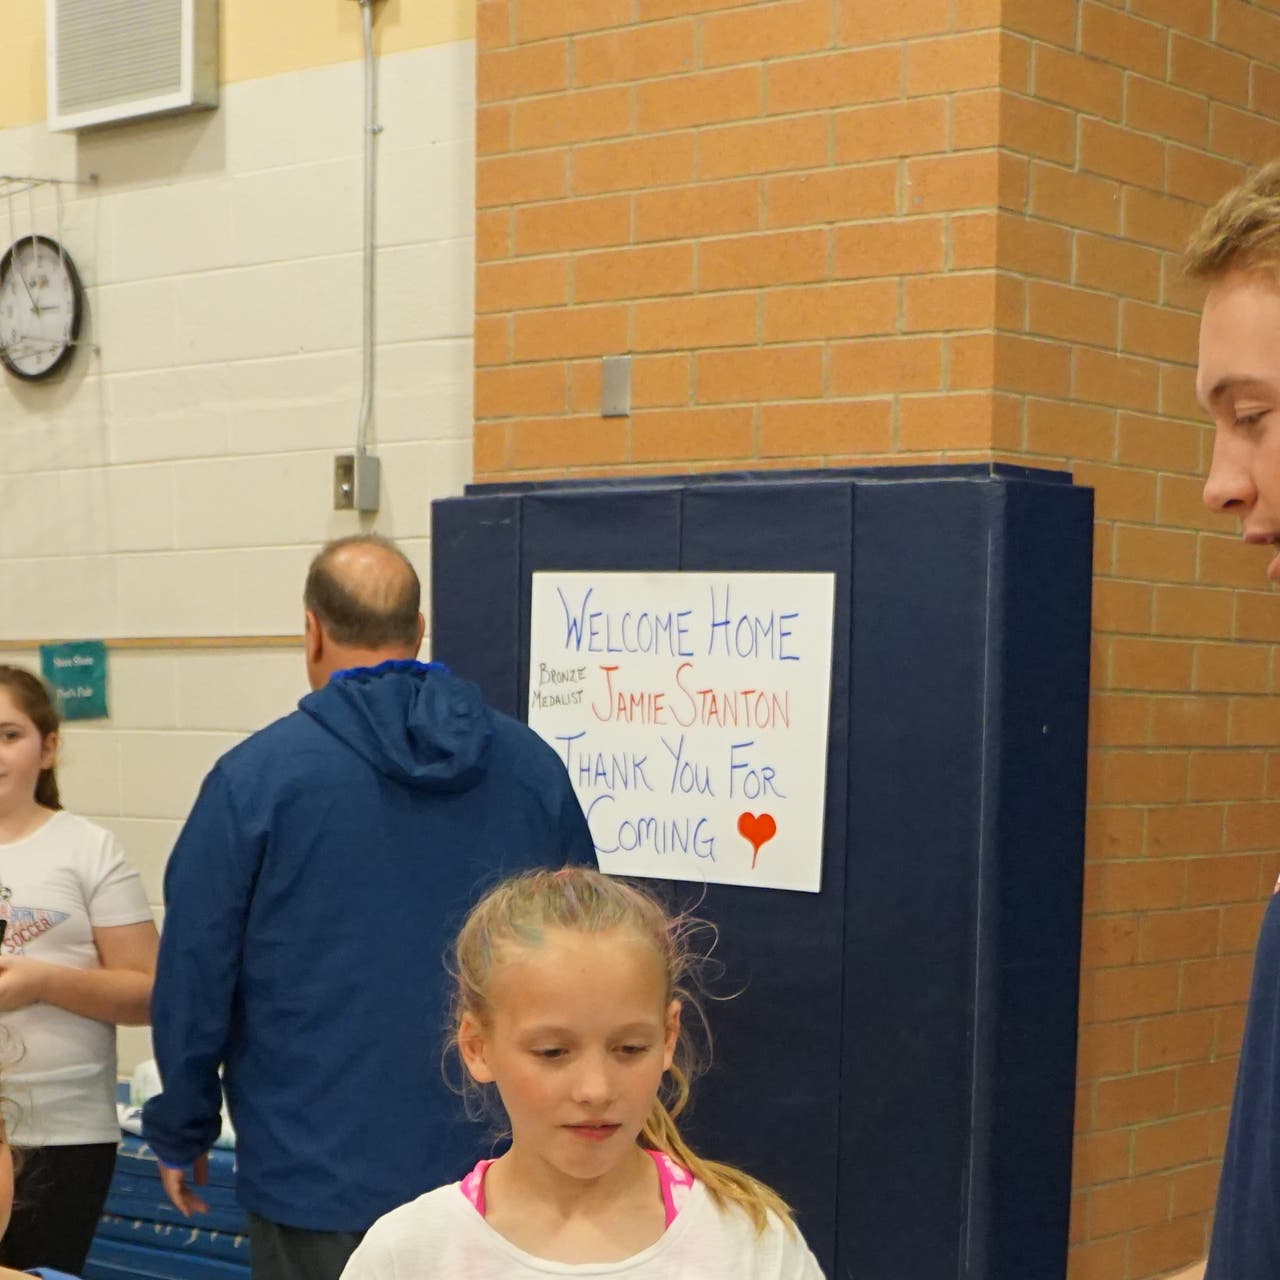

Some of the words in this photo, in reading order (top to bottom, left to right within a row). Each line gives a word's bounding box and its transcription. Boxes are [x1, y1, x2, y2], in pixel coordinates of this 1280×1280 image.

[556, 586, 695, 657] WELCOME
[708, 583, 801, 661] HOME
[531, 689, 585, 710] MEDALIST
[538, 662, 587, 686] BRONZE
[591, 664, 668, 722] JAMIE
[667, 661, 791, 729] STANTON
[554, 731, 655, 792] THANK
[660, 734, 716, 798] YOU
[729, 741, 788, 800] FOR
[585, 794, 717, 863] COMING
[4, 917, 53, 953] SOCCER
